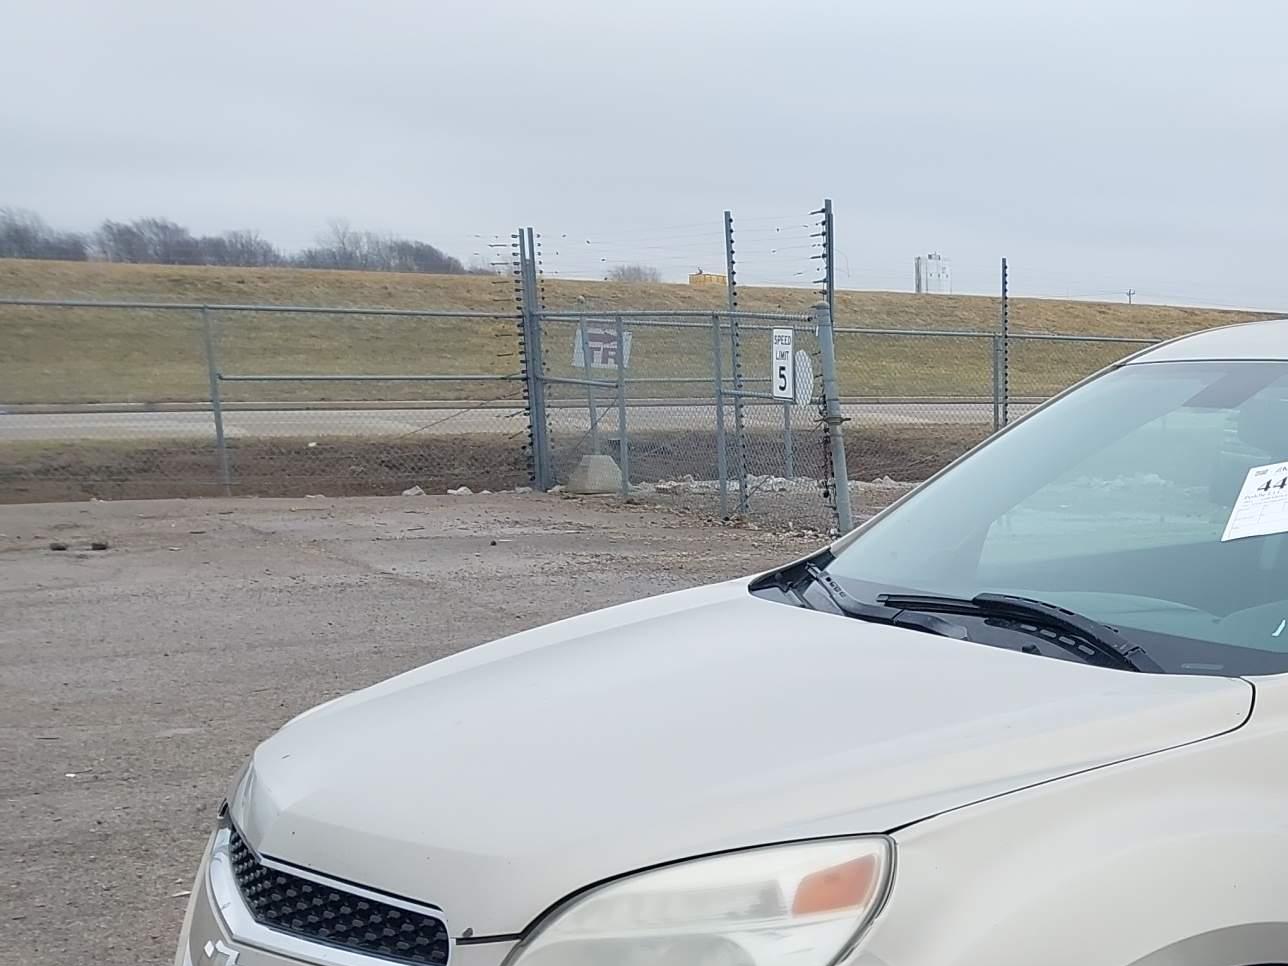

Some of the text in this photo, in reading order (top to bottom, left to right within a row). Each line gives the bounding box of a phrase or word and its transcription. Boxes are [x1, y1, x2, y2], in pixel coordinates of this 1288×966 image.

[774, 335, 791, 345] SPEED
[775, 350, 790, 361] LIMIT
[778, 365, 787, 391] 5
